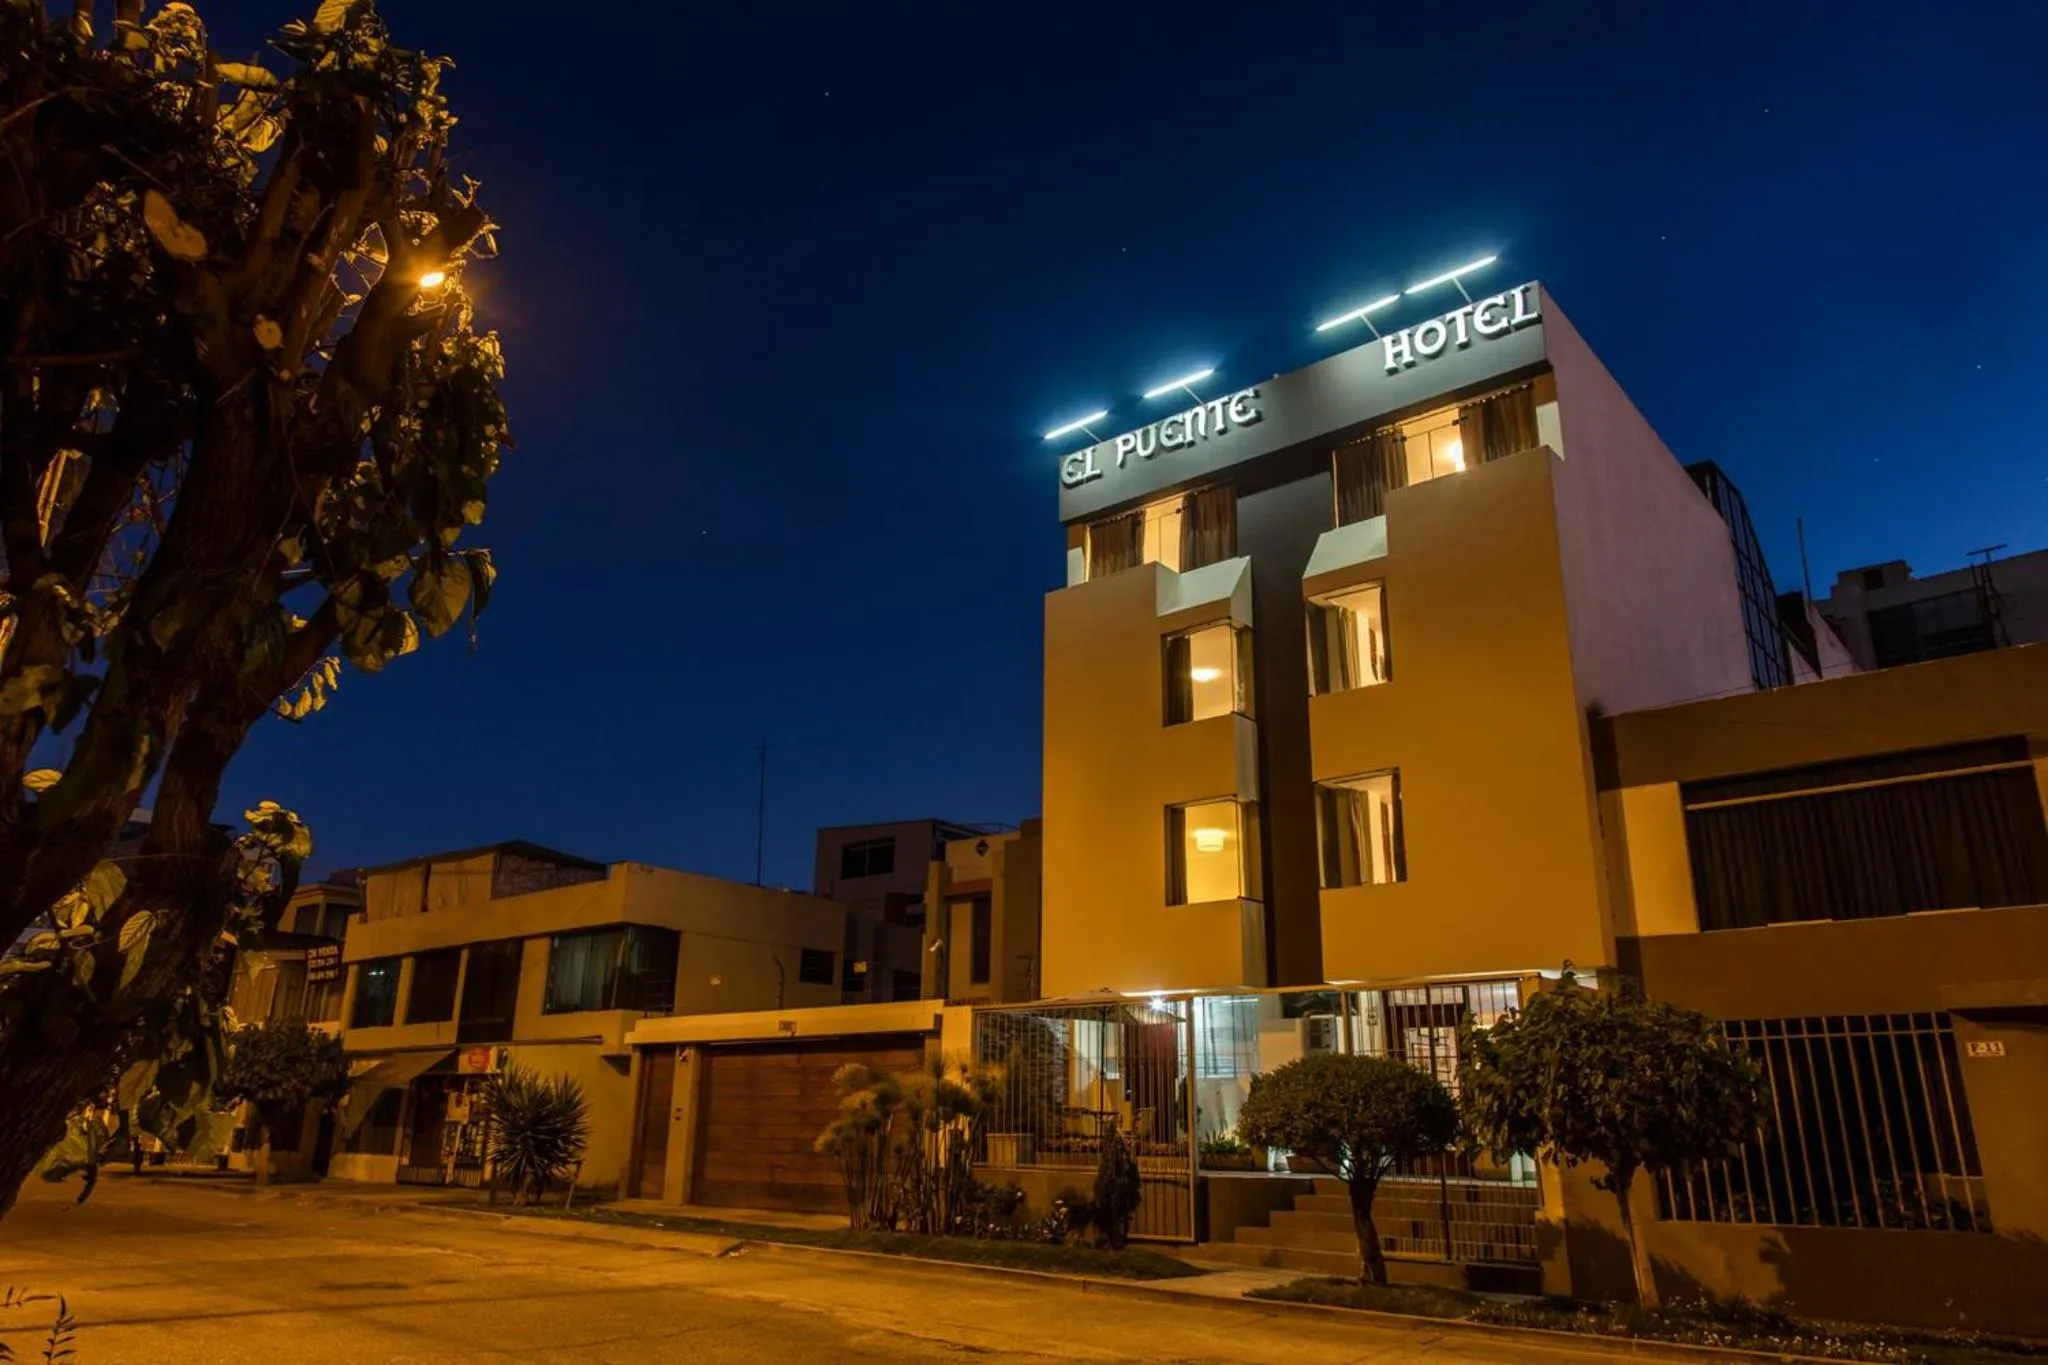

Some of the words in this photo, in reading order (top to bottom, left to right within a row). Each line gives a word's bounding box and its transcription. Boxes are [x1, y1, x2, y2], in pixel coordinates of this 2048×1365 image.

[1061, 446, 1102, 486] EL
[1115, 388, 1261, 467] PUENTE
[1383, 283, 1540, 371] HOTEL
